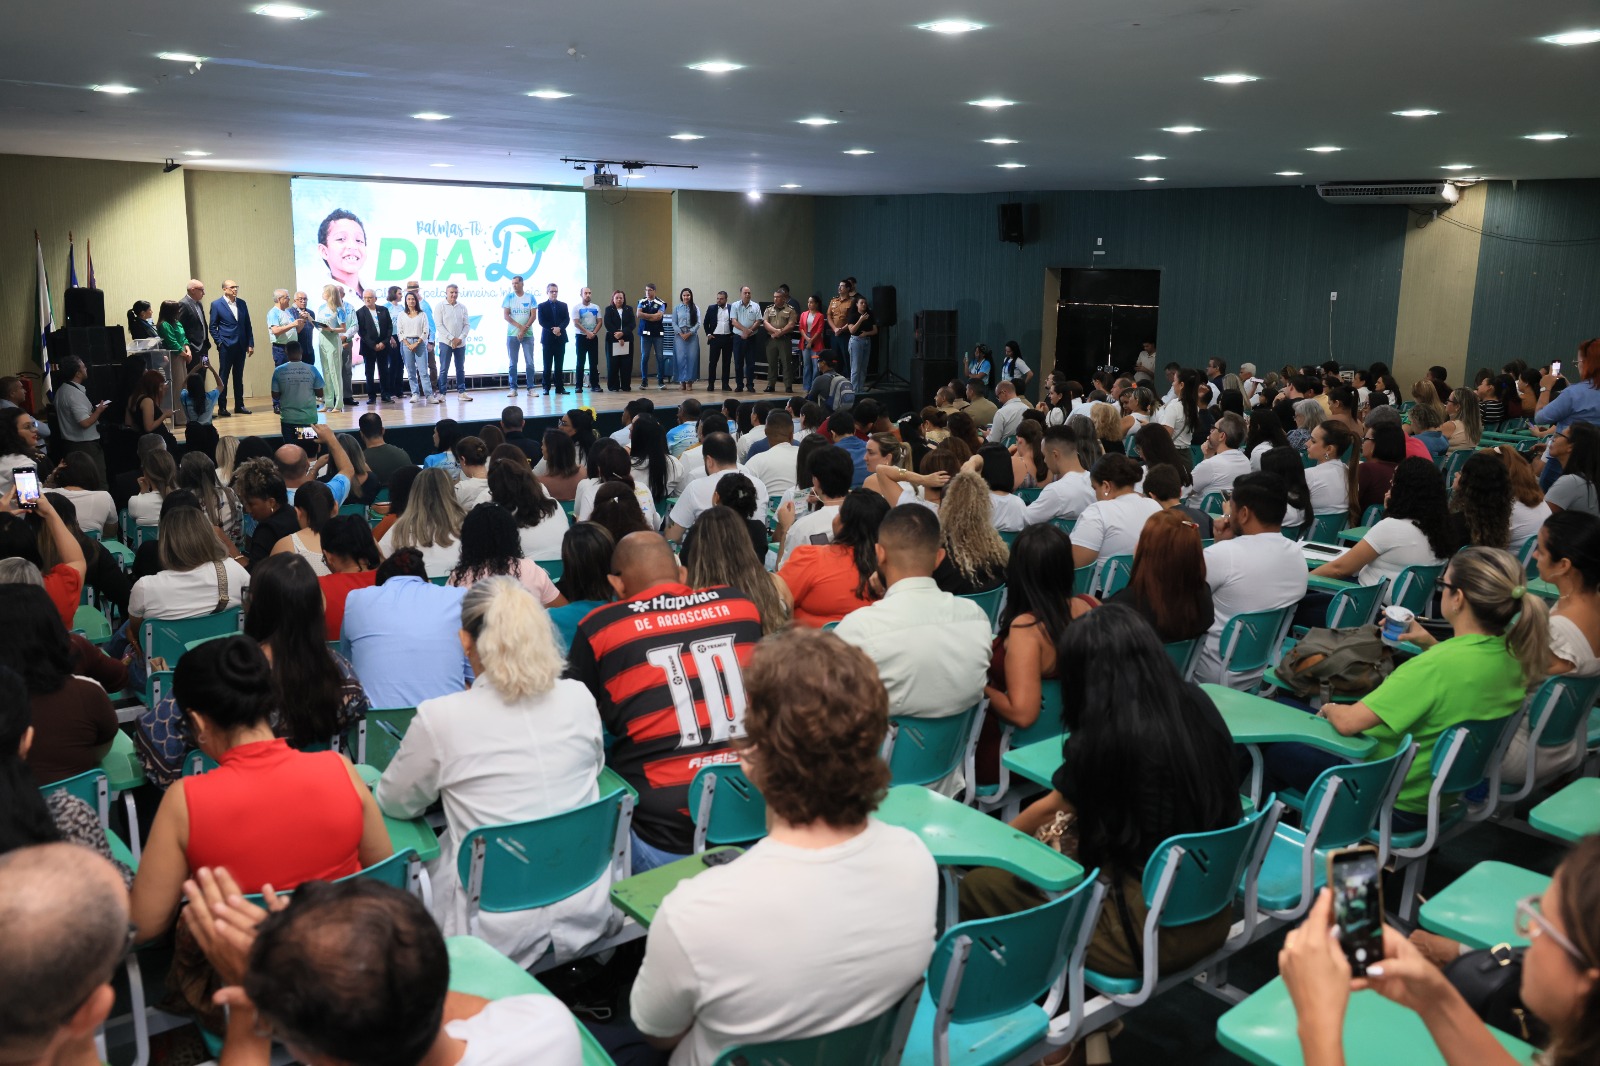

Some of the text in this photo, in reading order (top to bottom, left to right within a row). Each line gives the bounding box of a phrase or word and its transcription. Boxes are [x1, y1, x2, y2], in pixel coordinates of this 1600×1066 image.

[375, 216, 543, 282] DIA D
[459, 287, 498, 298] rimeira
[652, 590, 720, 610] Hapvida
[634, 605, 731, 632] DE ARRASCAETA
[646, 633, 749, 750] 10
